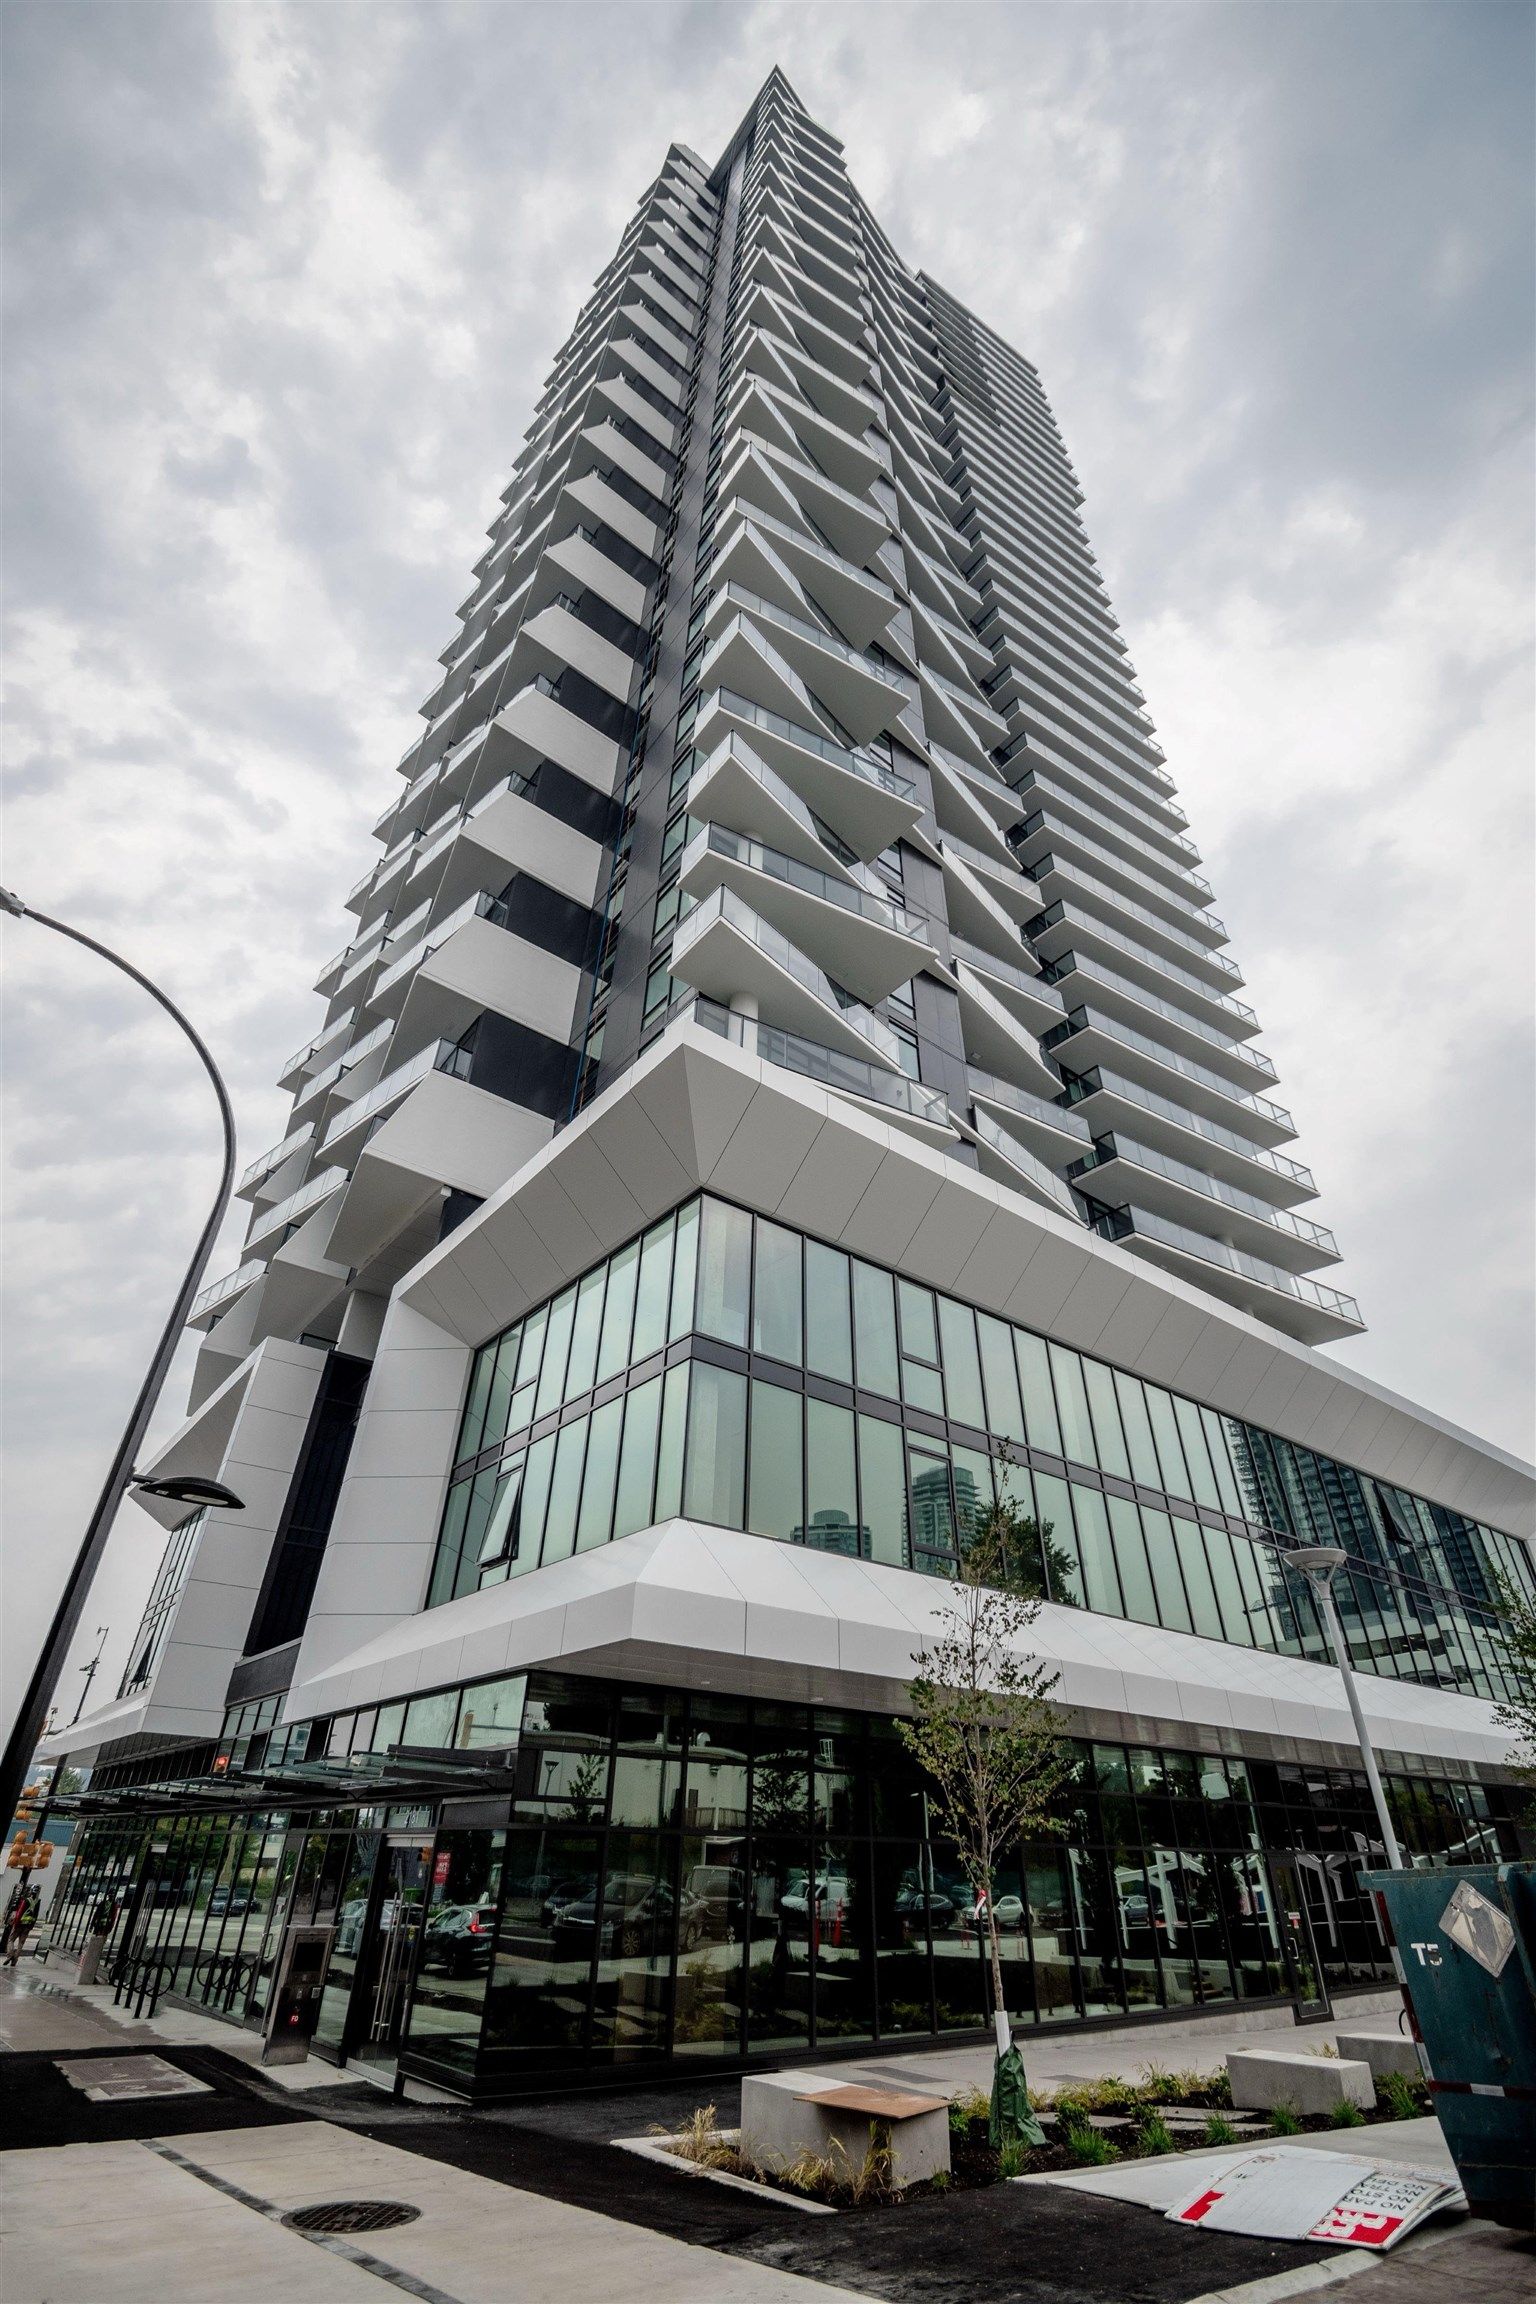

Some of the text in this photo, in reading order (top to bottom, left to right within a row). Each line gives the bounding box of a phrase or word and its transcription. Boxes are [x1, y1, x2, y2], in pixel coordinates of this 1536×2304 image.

[1403, 2182, 1428, 2191] NO
[1396, 2188, 1421, 2197] NO
[1388, 2194, 1414, 2203] NO
[1381, 2202, 1406, 2210] NO
